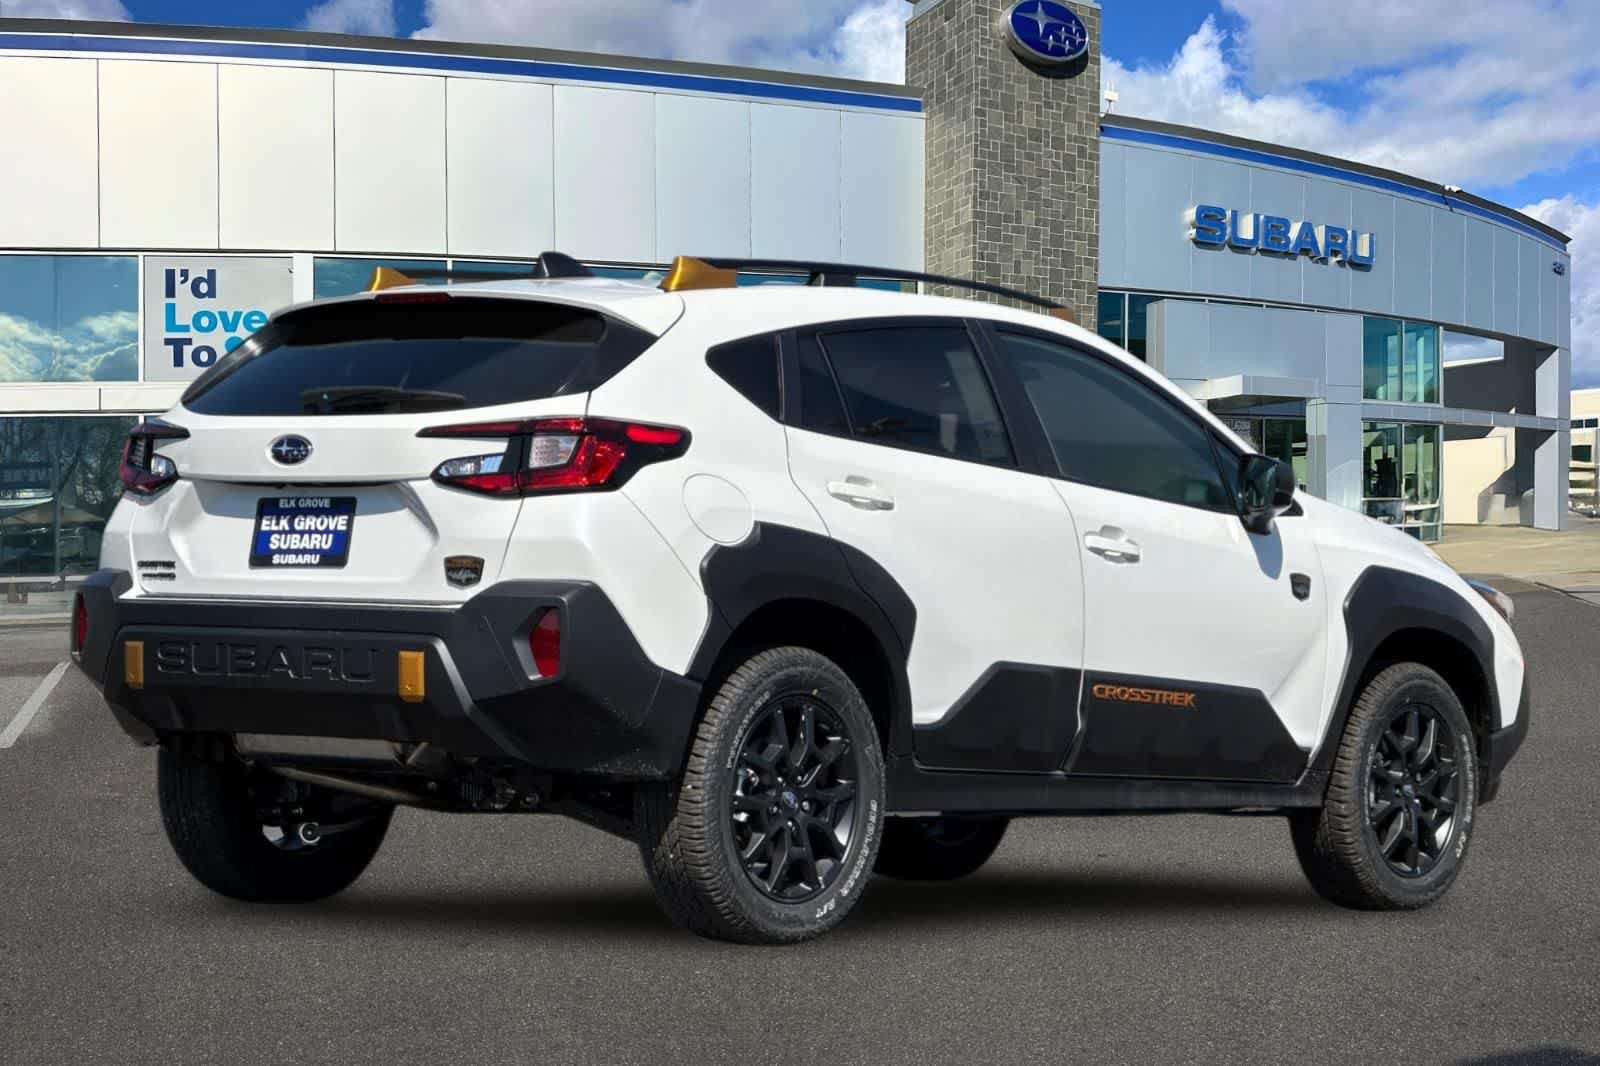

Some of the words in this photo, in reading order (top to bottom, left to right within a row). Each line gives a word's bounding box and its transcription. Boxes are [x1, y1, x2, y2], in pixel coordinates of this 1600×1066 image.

[1192, 204, 1376, 266] SUBARU
[164, 268, 217, 299] I'd
[164, 302, 269, 333] Love
[163, 337, 217, 368] To
[279, 498, 296, 508] ELK
[298, 498, 331, 508] GROVE
[261, 515, 291, 531] ELK
[293, 515, 349, 531] GROVE
[269, 533, 333, 549] SUBARU
[271, 554, 320, 565] SUBARU
[156, 641, 379, 682] SUBARU
[1092, 683, 1196, 707] CROSSTREK
